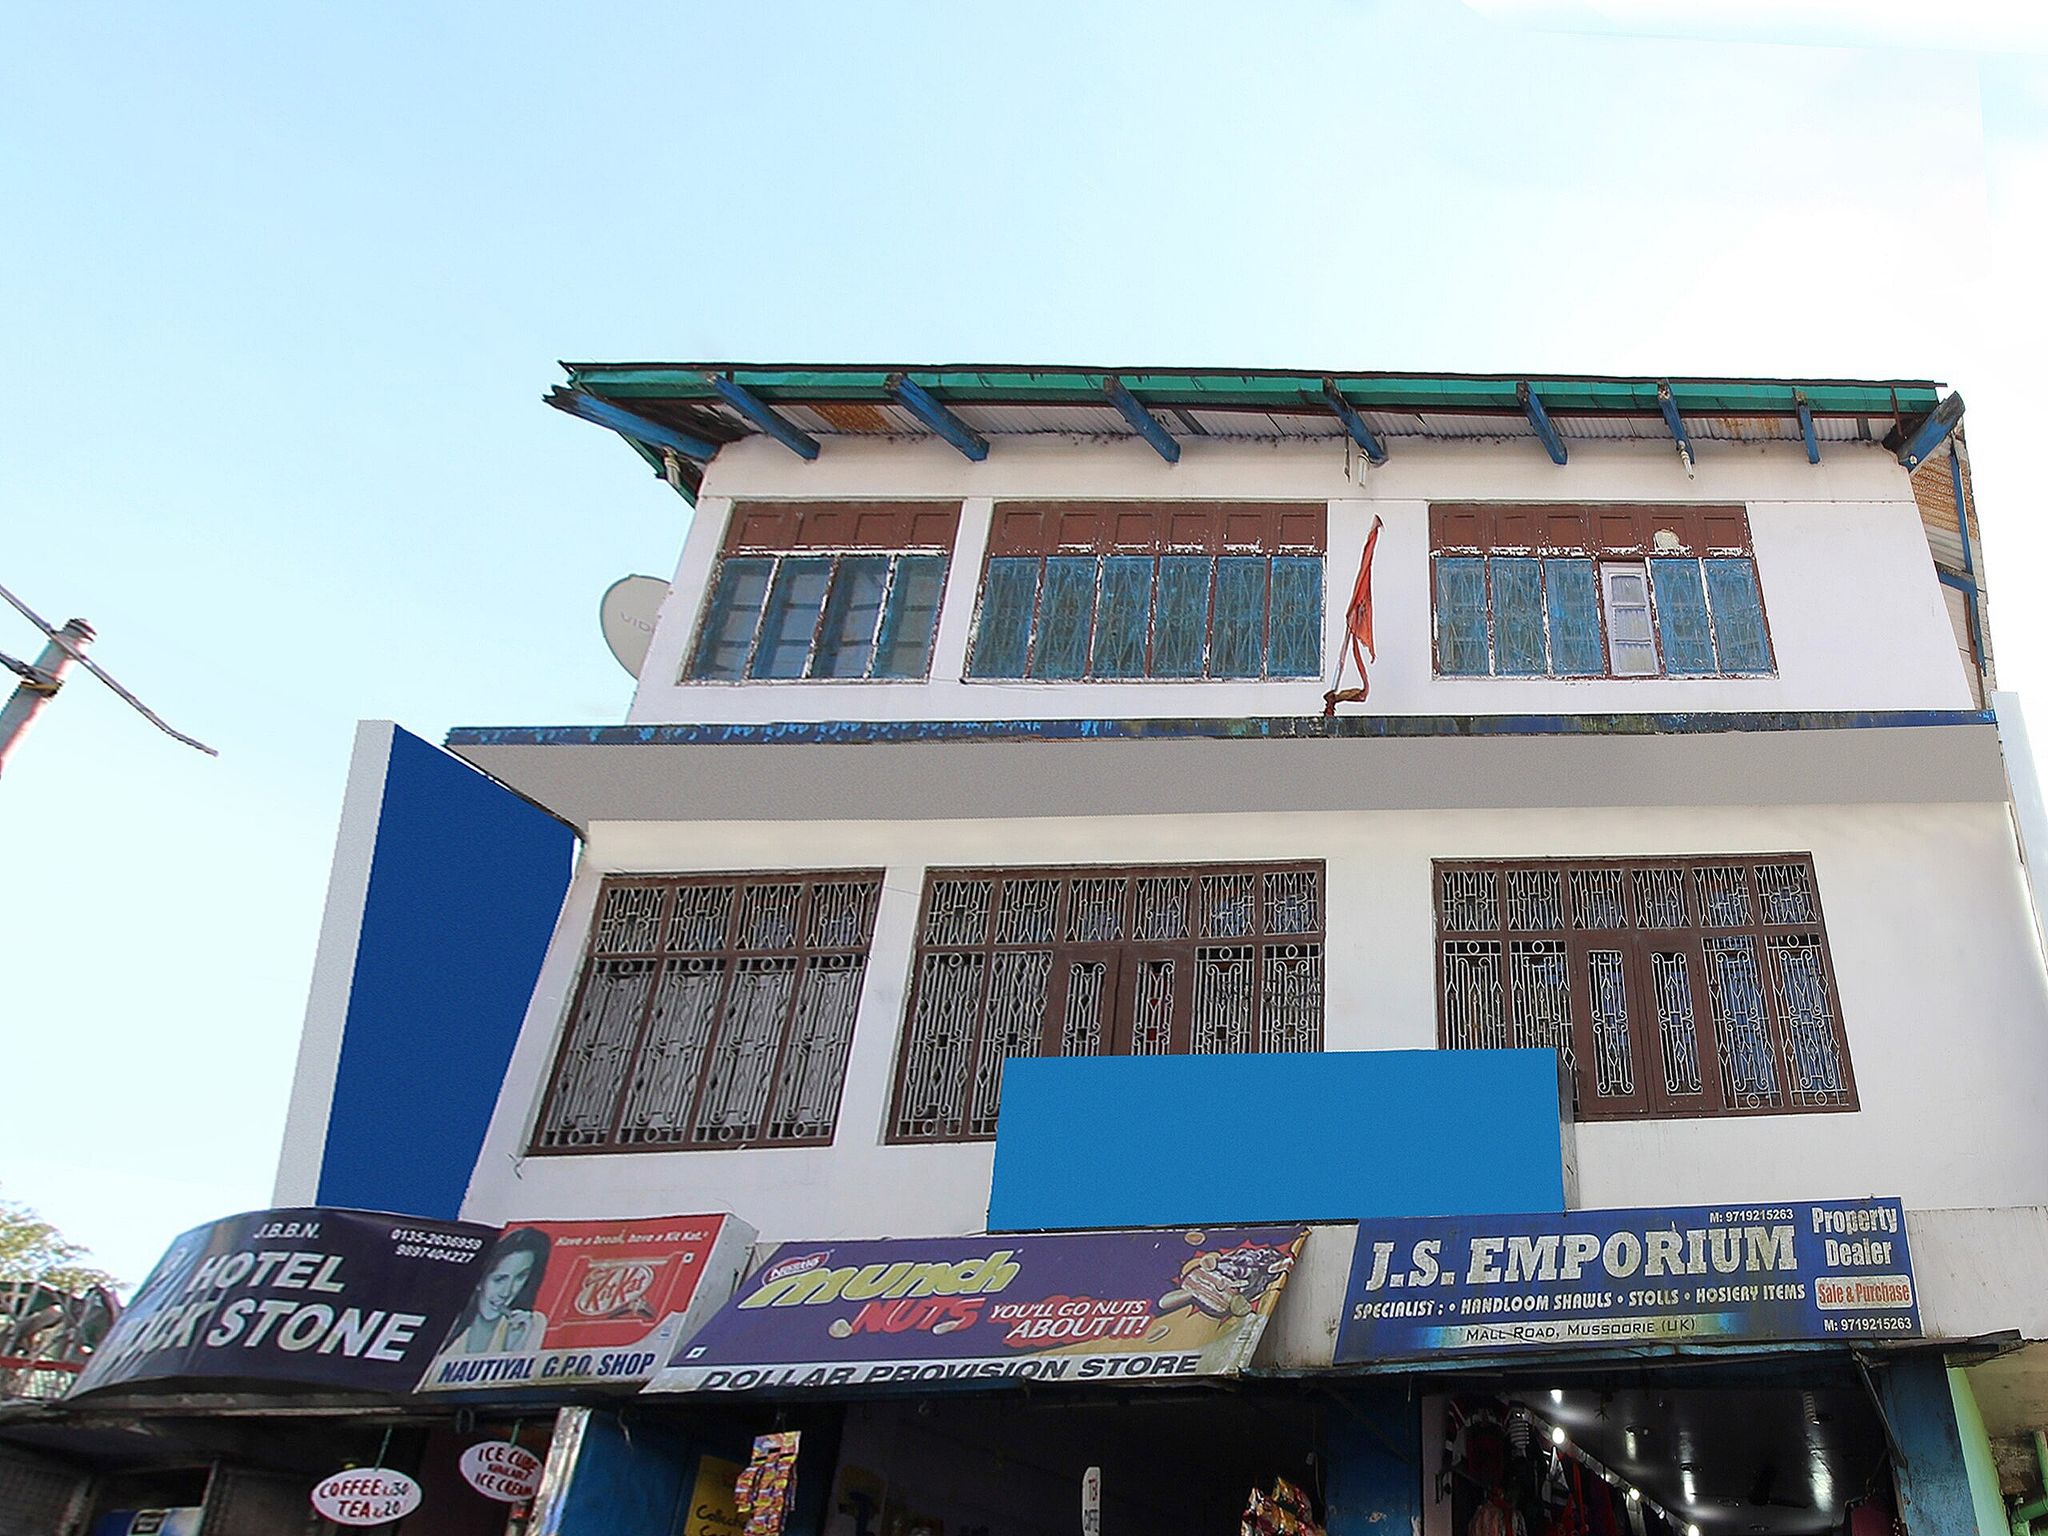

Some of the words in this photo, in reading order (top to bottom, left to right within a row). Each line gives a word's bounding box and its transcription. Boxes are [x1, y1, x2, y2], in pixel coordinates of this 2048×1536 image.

[1709, 1212, 1723, 1224] M:
[1725, 1209, 1794, 1223] 9719215263
[1811, 1206, 1898, 1235] Property
[253, 1222, 320, 1239] J.B.B.N.
[1365, 1239, 1456, 1292] J.S.
[1465, 1224, 1798, 1285] EMPORIUM
[1824, 1238, 1892, 1267] Dealer
[187, 1251, 345, 1294] HOTEL
[1460, 1295, 1550, 1316] HANDLOOM
[1553, 1291, 1613, 1310] SHAWLS
[1627, 1288, 1680, 1308] STOLLS
[1695, 1285, 1759, 1305] HOSIERY
[1762, 1283, 1807, 1302] ITEMS
[1818, 1283, 1845, 1304] Sale
[1845, 1286, 1856, 1303] &
[1855, 1281, 1911, 1303] Purchase
[850, 1297, 986, 1335] NUTS
[990, 1303, 1054, 1319] YOU'LL
[1056, 1301, 1091, 1317] GO
[1091, 1300, 1148, 1315] NUTS
[206, 1298, 427, 1362] STONE
[1004, 1316, 1116, 1341] ABOUT
[1111, 1314, 1151, 1336] IT!
[1466, 1328, 1508, 1342] MALL
[1512, 1325, 1561, 1341] ROAD,
[1566, 1321, 1656, 1337] MUSSOORIE
[1660, 1317, 1696, 1334] (UK)
[1823, 1318, 1839, 1332] M:
[1840, 1316, 1913, 1331] 9719215263
[437, 1357, 536, 1383] NAUTIYAL
[541, 1354, 592, 1378] G.P.O.
[597, 1352, 656, 1377] SHOP
[697, 1367, 857, 1392] DOLLAR
[862, 1358, 1071, 1383] PROVISION
[1077, 1353, 1202, 1379] STORE
[477, 1447, 504, 1462] ICE
[319, 1479, 383, 1499] COFFEE
[474, 1472, 496, 1490] ICE
[337, 1500, 370, 1518] TEA
